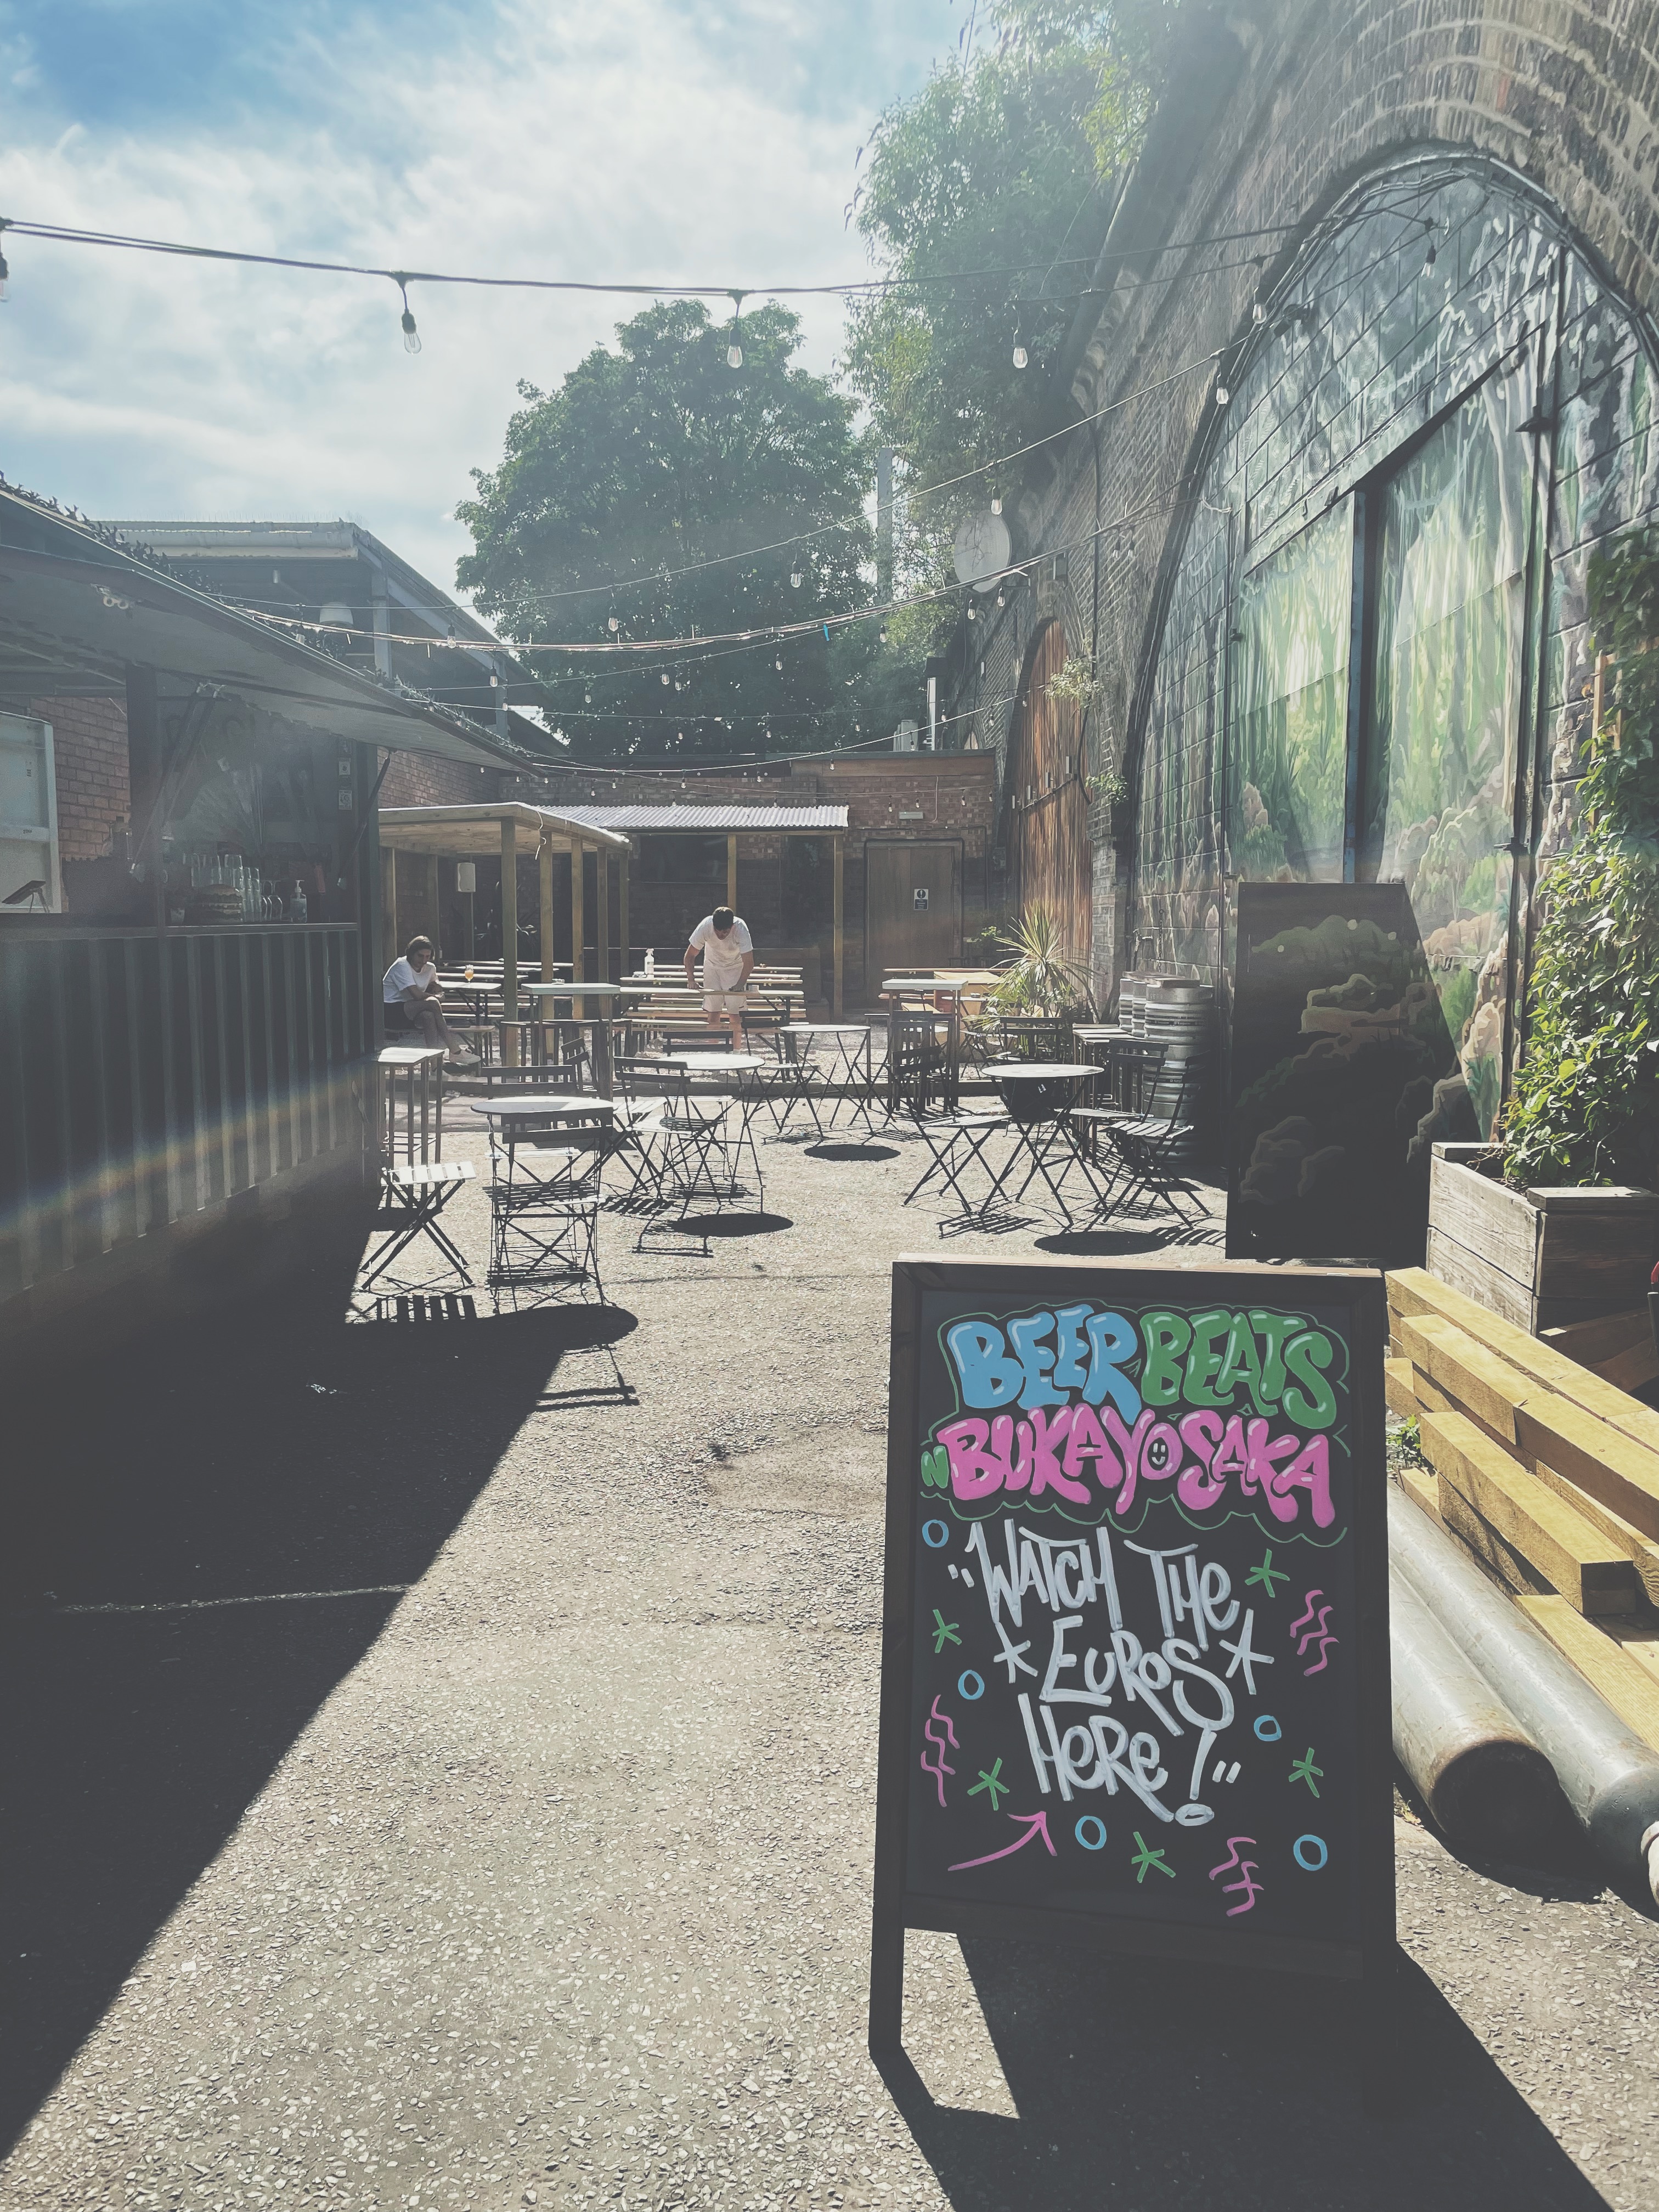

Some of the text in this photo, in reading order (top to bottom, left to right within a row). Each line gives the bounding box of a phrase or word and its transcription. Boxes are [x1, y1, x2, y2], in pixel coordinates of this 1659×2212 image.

[947, 1304, 1337, 1429] BEER BEATS
[936, 1403, 1184, 1515] BUKAYO
[1178, 1410, 1336, 1528] SAKA
